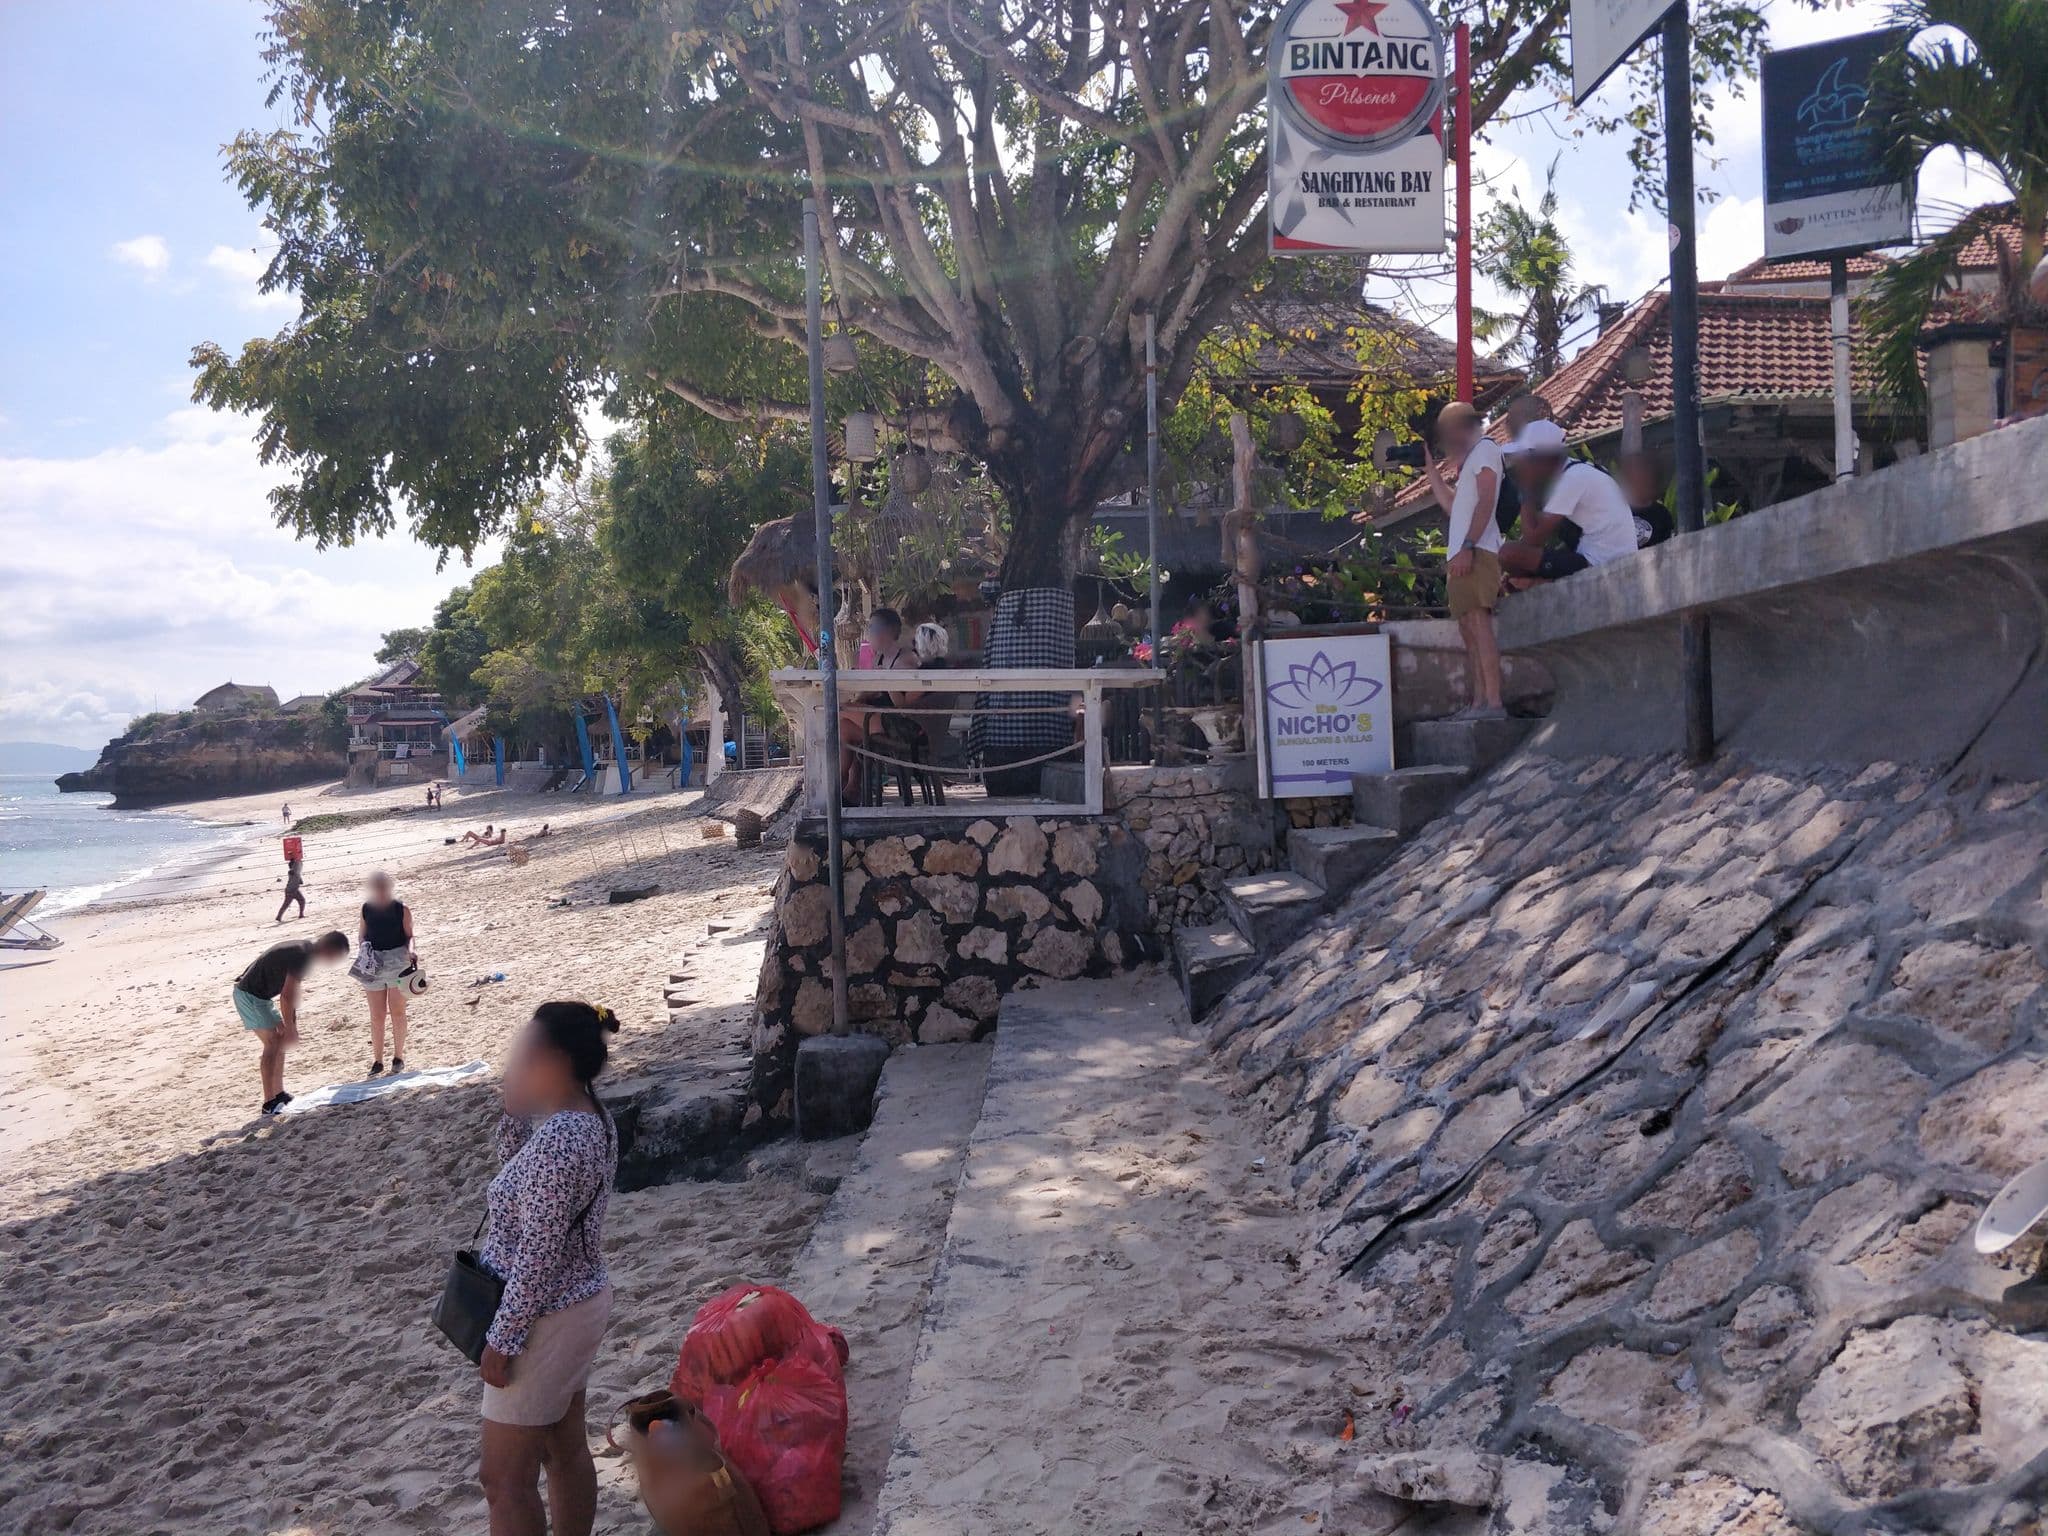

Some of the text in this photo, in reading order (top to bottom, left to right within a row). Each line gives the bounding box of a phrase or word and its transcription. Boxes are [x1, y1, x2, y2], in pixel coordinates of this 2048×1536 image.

[1291, 41, 1429, 71] BINTANG
[1320, 83, 1399, 105] Pilsener
[1301, 171, 1432, 194] SANGHYANG BAY
[1318, 197, 1416, 208] BAR & RESTAURANT
[1807, 208, 1857, 224] HATTEN
[1277, 713, 1373, 736] NICHO'S
[1277, 736, 1333, 746] BUNGALOWS
[1343, 734, 1373, 744] VILLAS
[1301, 758, 1350, 767] 100 METERS
